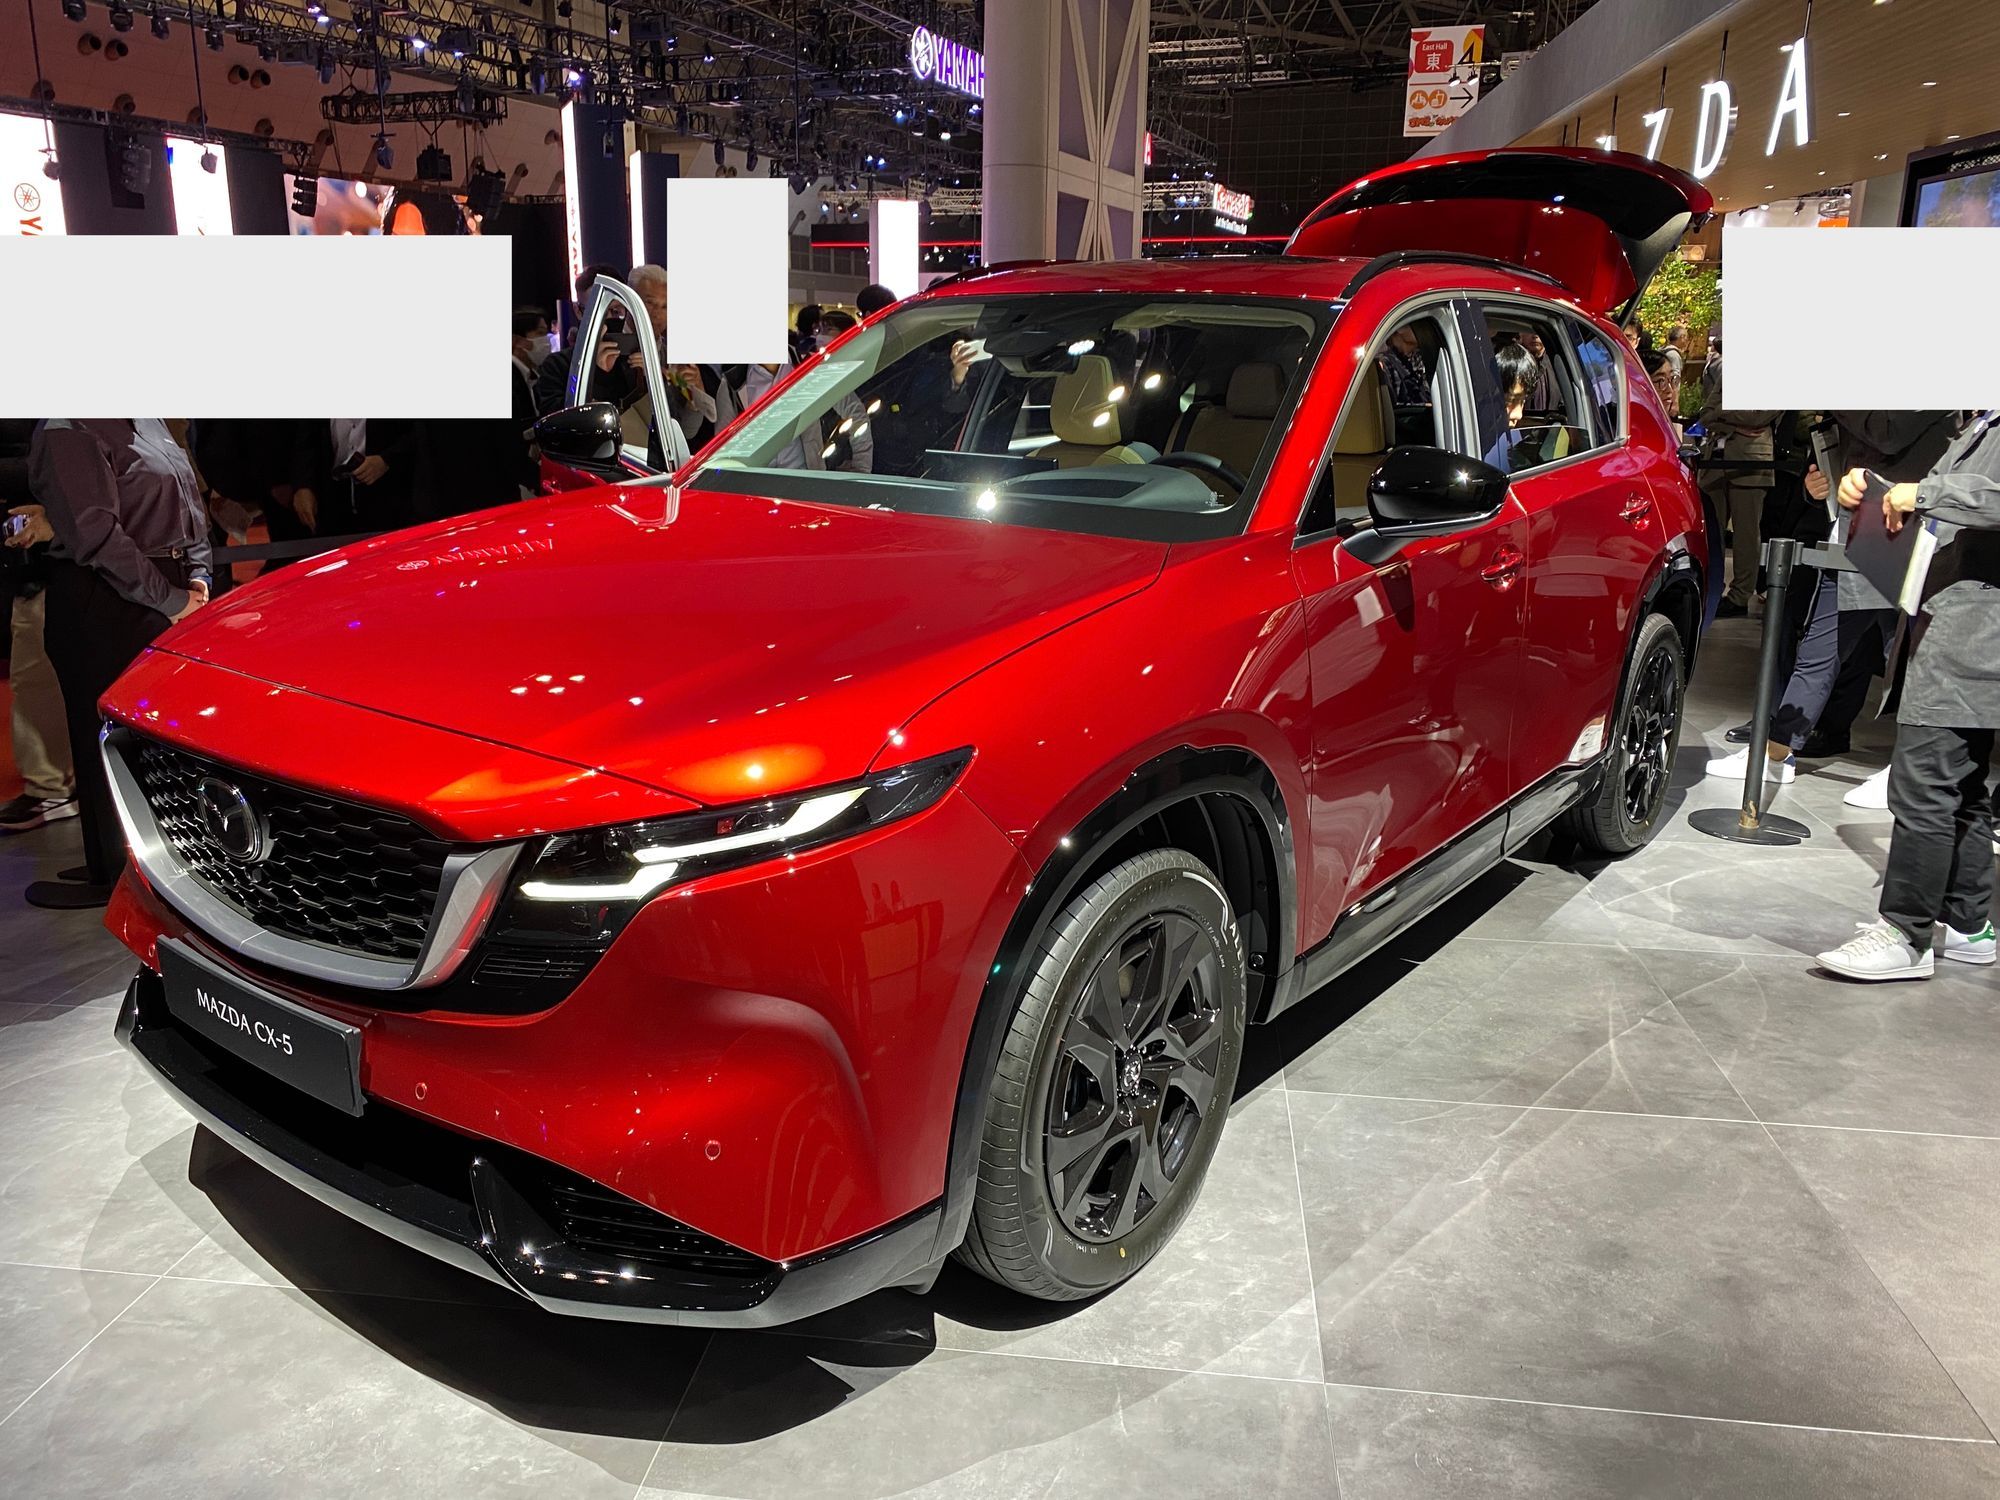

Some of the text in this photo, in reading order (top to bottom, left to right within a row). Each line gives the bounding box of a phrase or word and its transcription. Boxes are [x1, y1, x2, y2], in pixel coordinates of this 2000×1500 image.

[932, 33, 985, 99] YAMAH
[1422, 43, 1435, 51] East
[1426, 52, 1442, 71] 東
[1603, 36, 1812, 180] ZDA
[197, 987, 293, 1055] MAZDA CX-5
